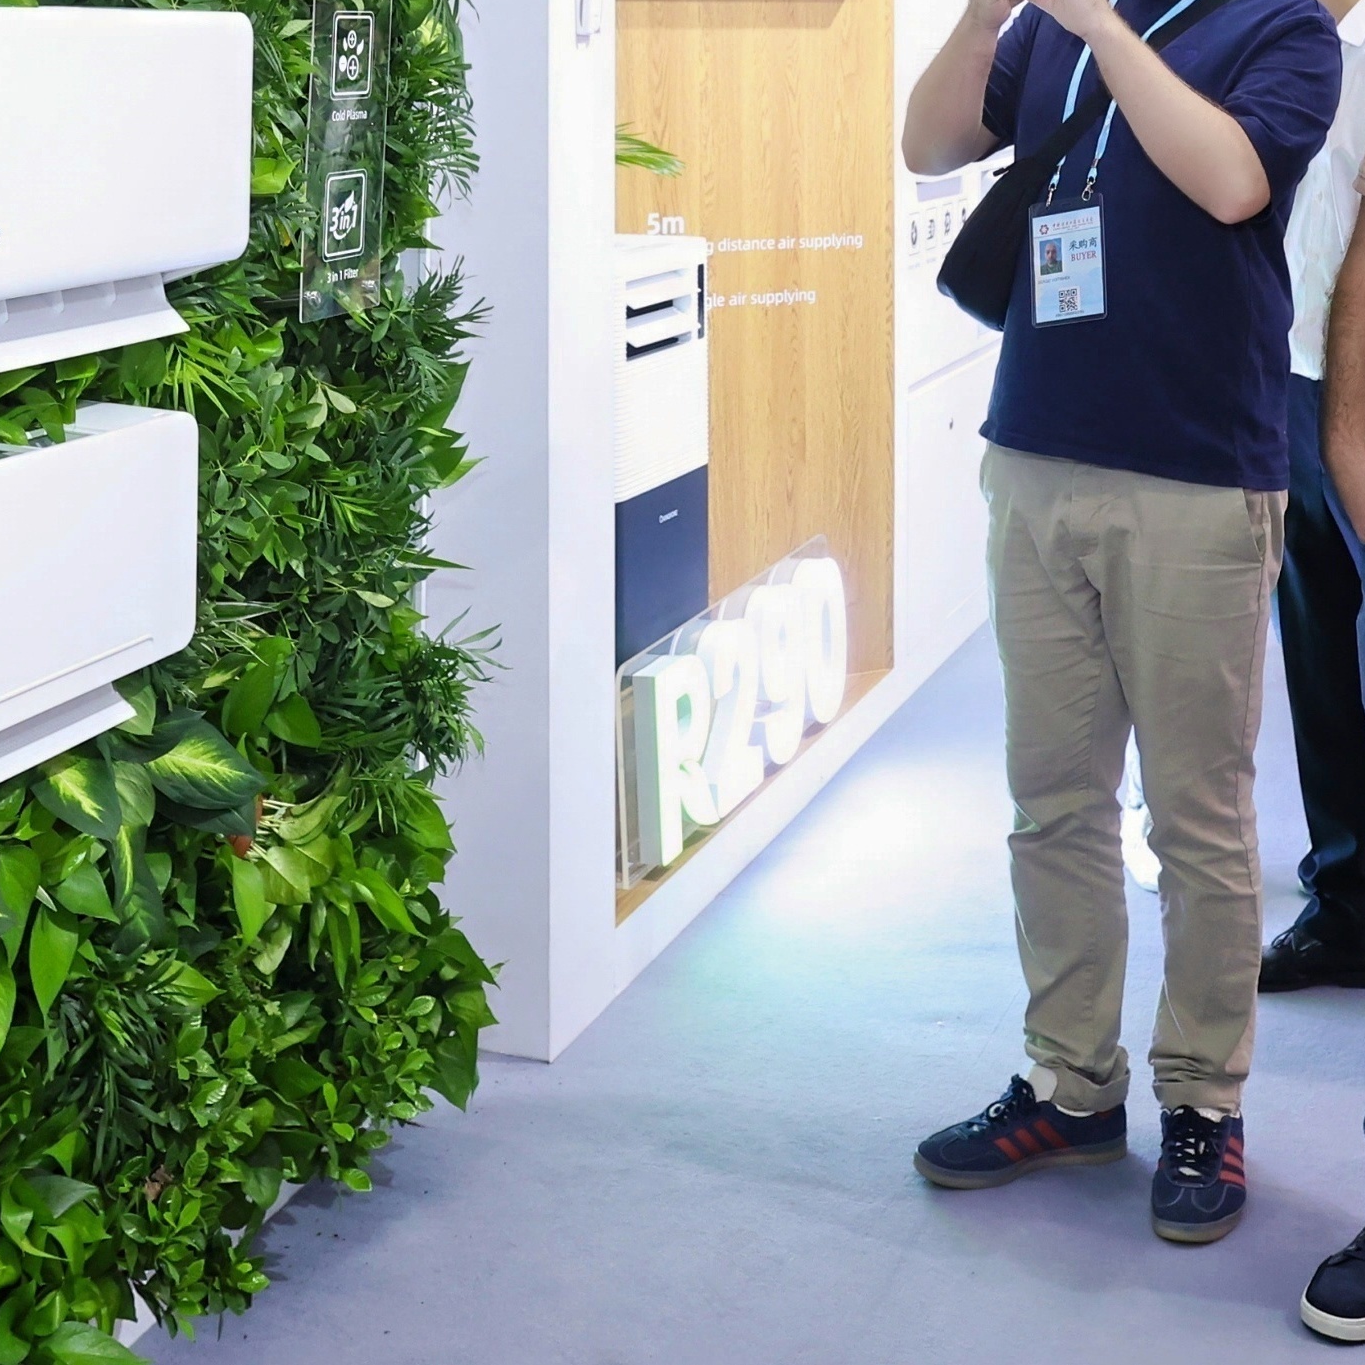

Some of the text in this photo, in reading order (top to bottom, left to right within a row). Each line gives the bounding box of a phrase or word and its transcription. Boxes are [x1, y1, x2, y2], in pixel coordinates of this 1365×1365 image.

[332, 108, 367, 121] Cold Plasma
[647, 212, 685, 235] 5m
[718, 237, 775, 253] distance
[778, 235, 795, 250] air
[799, 233, 863, 254] supplying
[1069, 237, 1098, 251] 采购商
[1071, 250, 1097, 262] BUYER
[332, 271, 338, 282] in
[344, 267, 359, 280] Filter
[729, 291, 746, 306] air
[750, 288, 816, 305] supplying
[636, 556, 847, 867] R290
